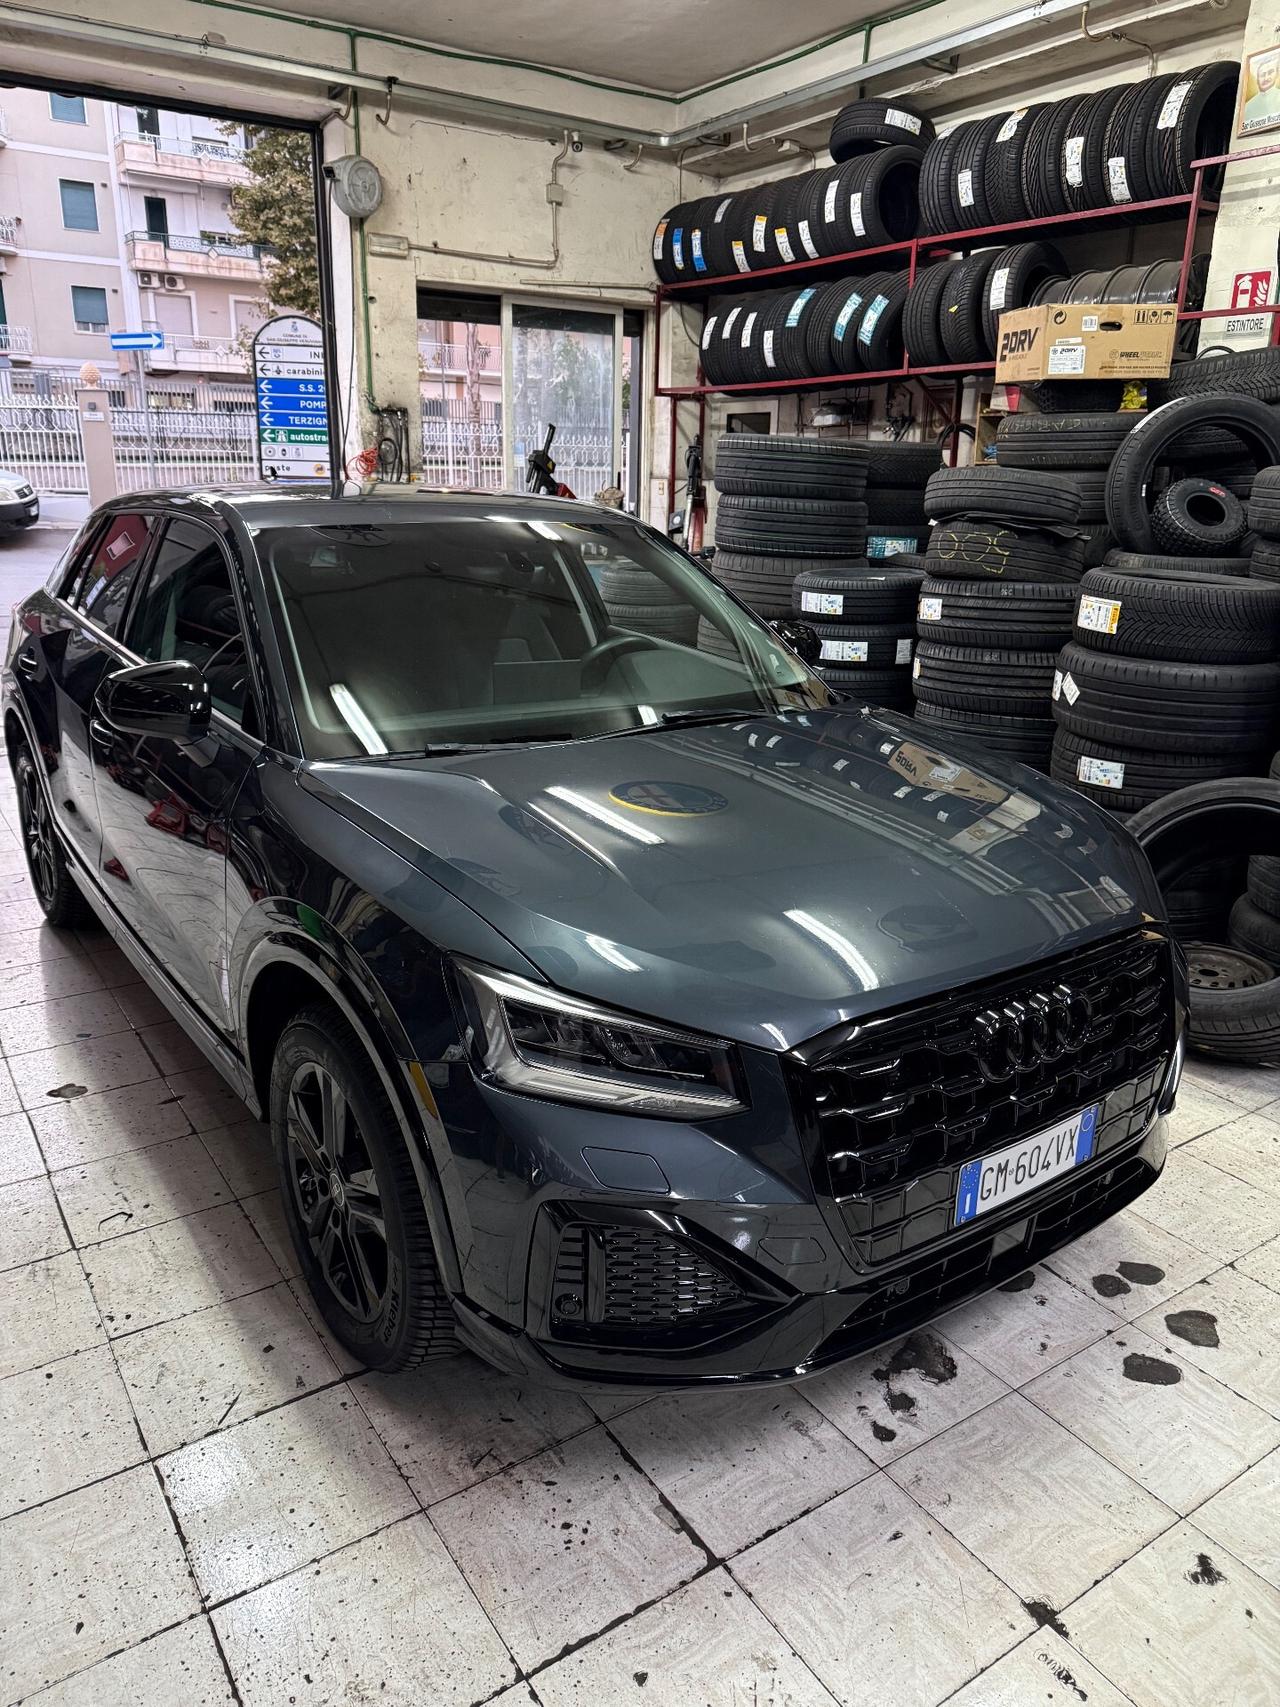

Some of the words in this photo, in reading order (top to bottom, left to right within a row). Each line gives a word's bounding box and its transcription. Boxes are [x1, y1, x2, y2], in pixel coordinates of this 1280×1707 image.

[1227, 318, 1264, 332] ESTINTORE
[999, 327, 1039, 362] 2DRV
[286, 368, 325, 376] carabini
[299, 384, 316, 392] S.S.
[318, 384, 325, 392] 2
[290, 432, 328, 442] autostra
[964, 1193, 971, 1214] I
[383, 1288, 400, 1343] Kleber
